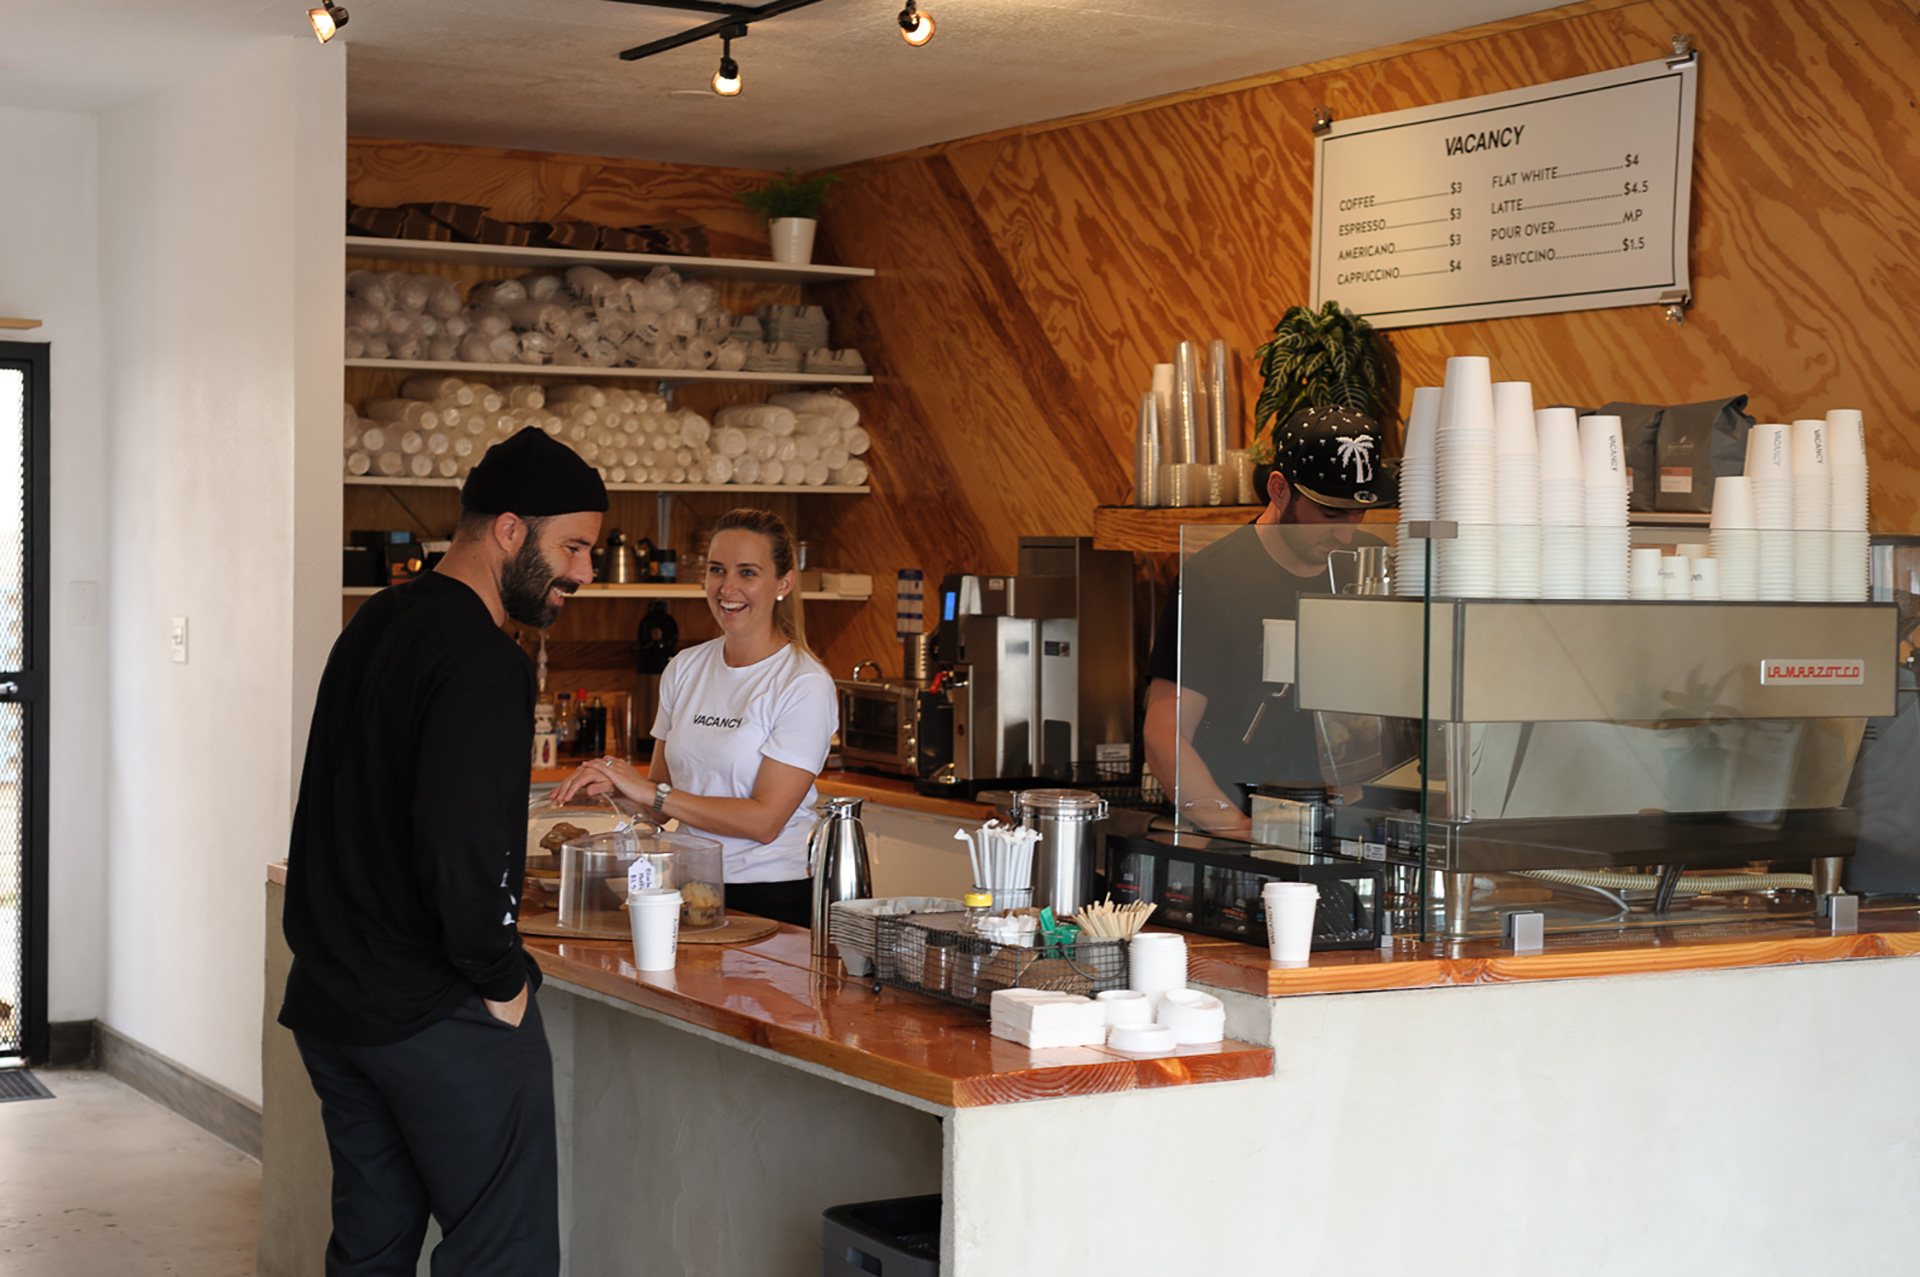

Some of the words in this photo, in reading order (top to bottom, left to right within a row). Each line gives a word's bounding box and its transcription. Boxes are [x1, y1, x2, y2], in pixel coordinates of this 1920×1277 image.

[1445, 125, 1525, 156] VACANCY
[1491, 172, 1517, 188] FLAT
[1520, 167, 1558, 184] WHITE
[1625, 153, 1639, 168] $4
[1339, 195, 1375, 212] COFFEE
[1450, 182, 1462, 195] $3
[1491, 198, 1523, 215] LATTE
[1624, 180, 1649, 195] $4.5
[1339, 218, 1386, 236] ESPRESSO
[1450, 207, 1462, 221] $3
[1491, 225, 1521, 241] POUR
[1524, 221, 1555, 237] OVER
[1622, 209, 1643, 224] MP
[1338, 242, 1395, 261] AMERICANO
[1449, 233, 1461, 247] $3
[1491, 248, 1555, 267] BABYCCINO
[1622, 236, 1645, 252] $1.5
[1337, 266, 1400, 285] CAPPUCCINO
[1449, 259, 1461, 273] $4
[1609, 434, 1619, 472] VACANCY
[1773, 430, 1782, 467] VACANCY
[1814, 429, 1824, 464] VACANCY
[693, 714, 743, 729] VACANCY
